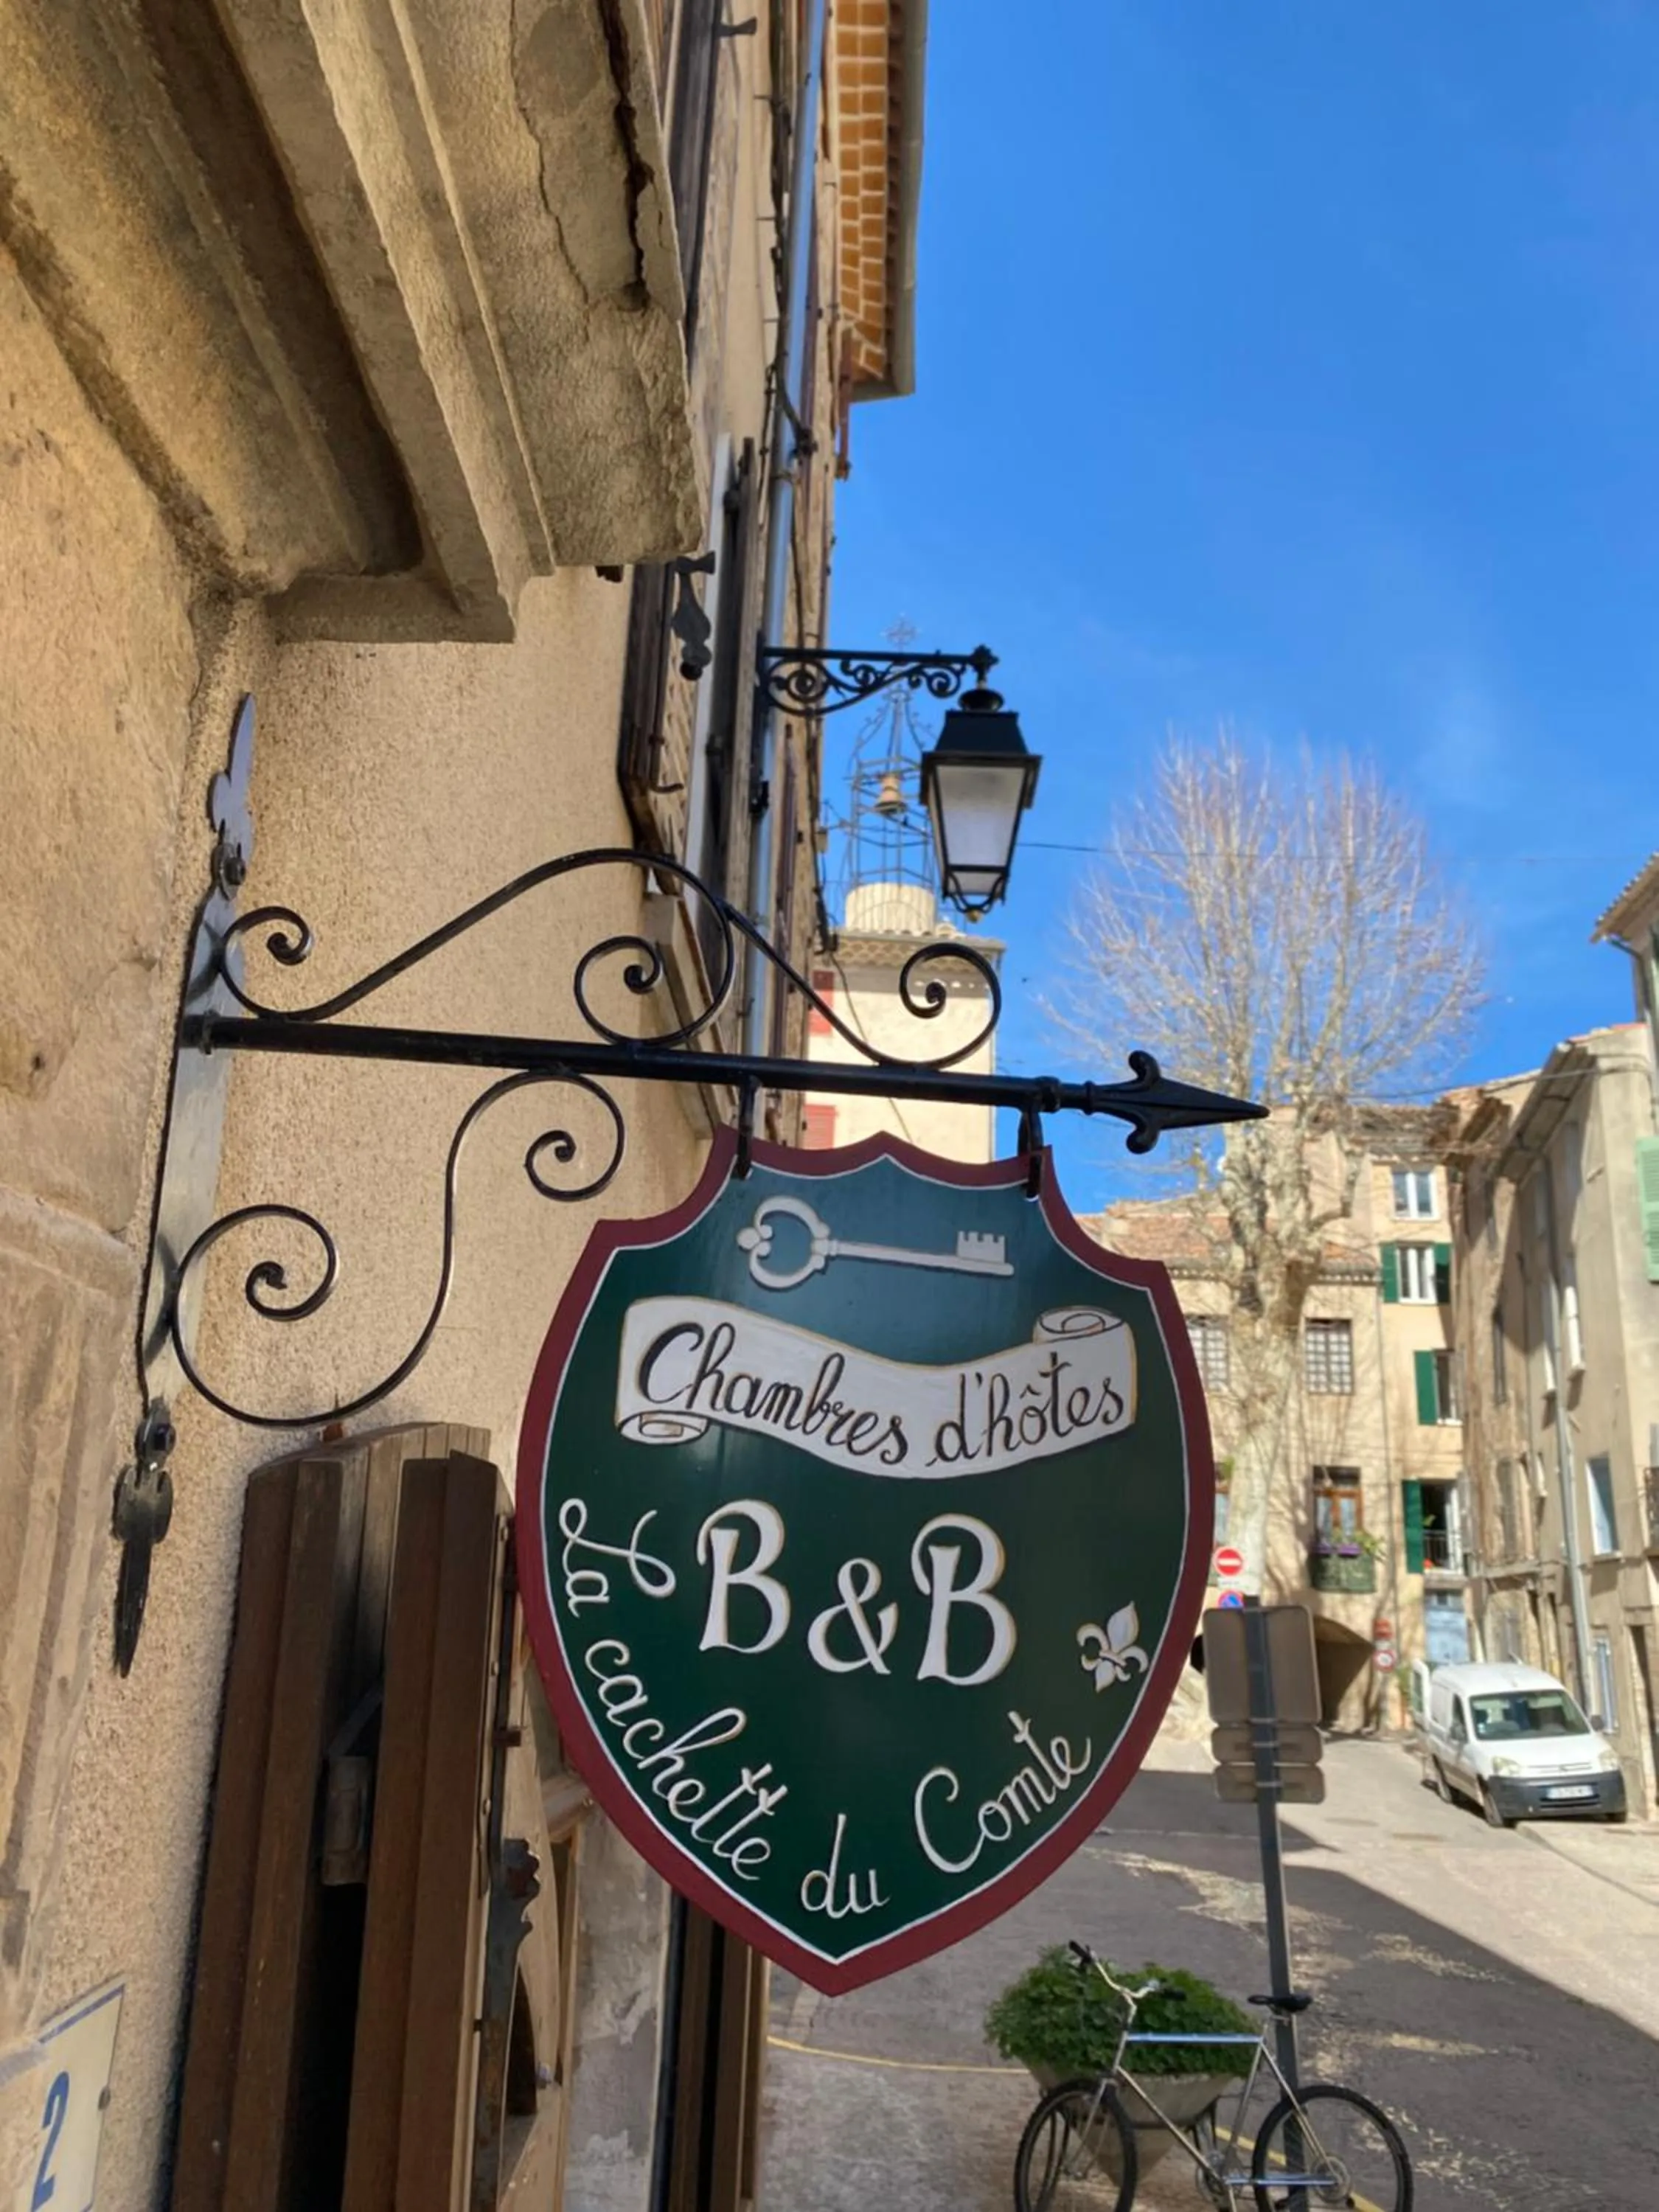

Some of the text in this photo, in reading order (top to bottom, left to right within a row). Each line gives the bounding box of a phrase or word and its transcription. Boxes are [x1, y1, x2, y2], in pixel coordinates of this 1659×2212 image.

[637, 1321, 1124, 1466] Chambres d'hôtes
[557, 1498, 1091, 1919] La cachette du Comte
[30, 2071, 69, 2212] 2
